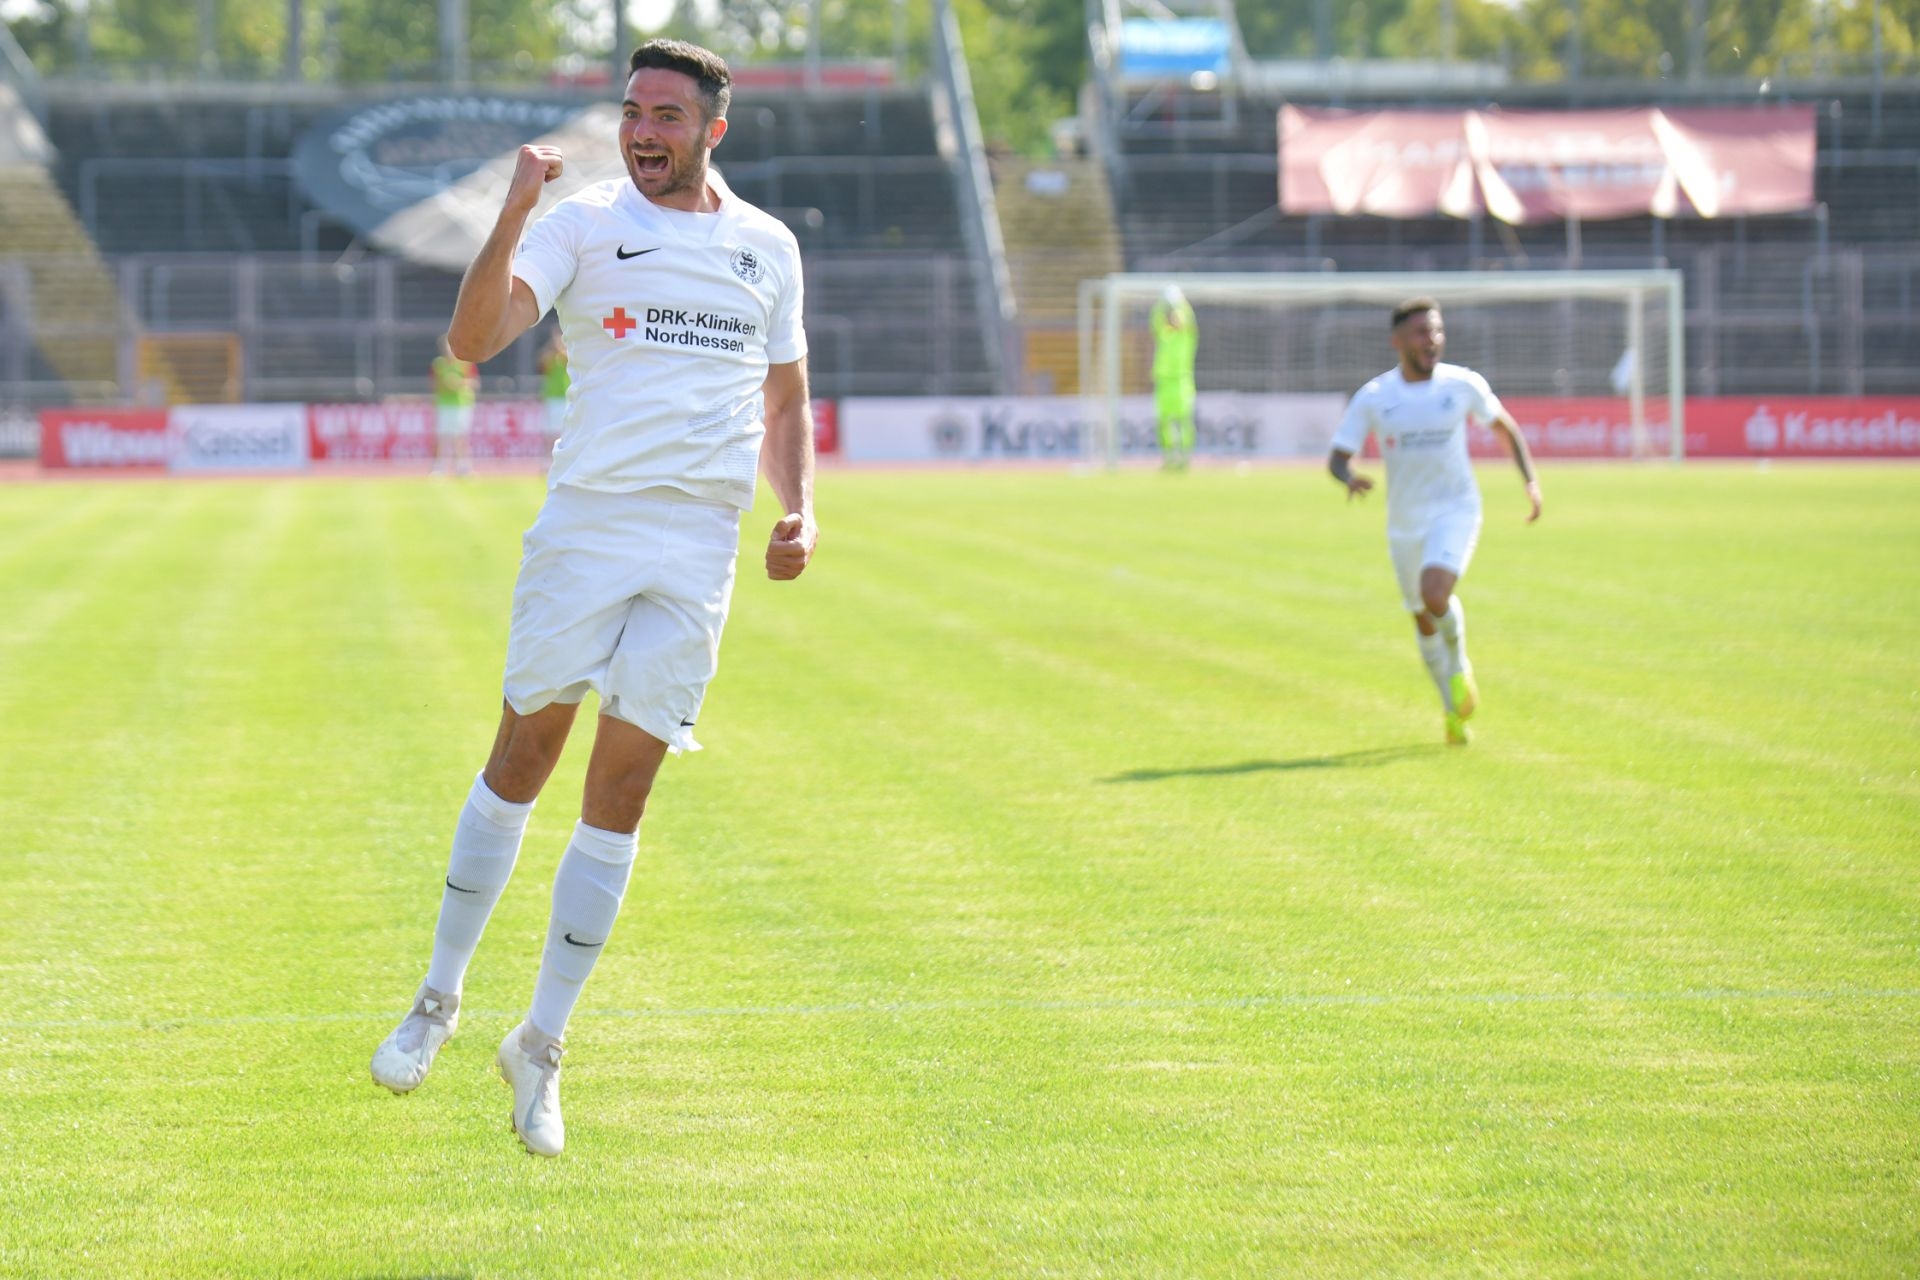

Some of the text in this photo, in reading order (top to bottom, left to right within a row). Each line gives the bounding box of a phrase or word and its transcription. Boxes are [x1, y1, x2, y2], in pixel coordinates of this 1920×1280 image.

[645, 327, 745, 352] Nordhessen
[646, 308, 757, 337] DRK-Kliniken
[981, 408, 1260, 453] Krobaher
[1783, 408, 1920, 450] Kassele
